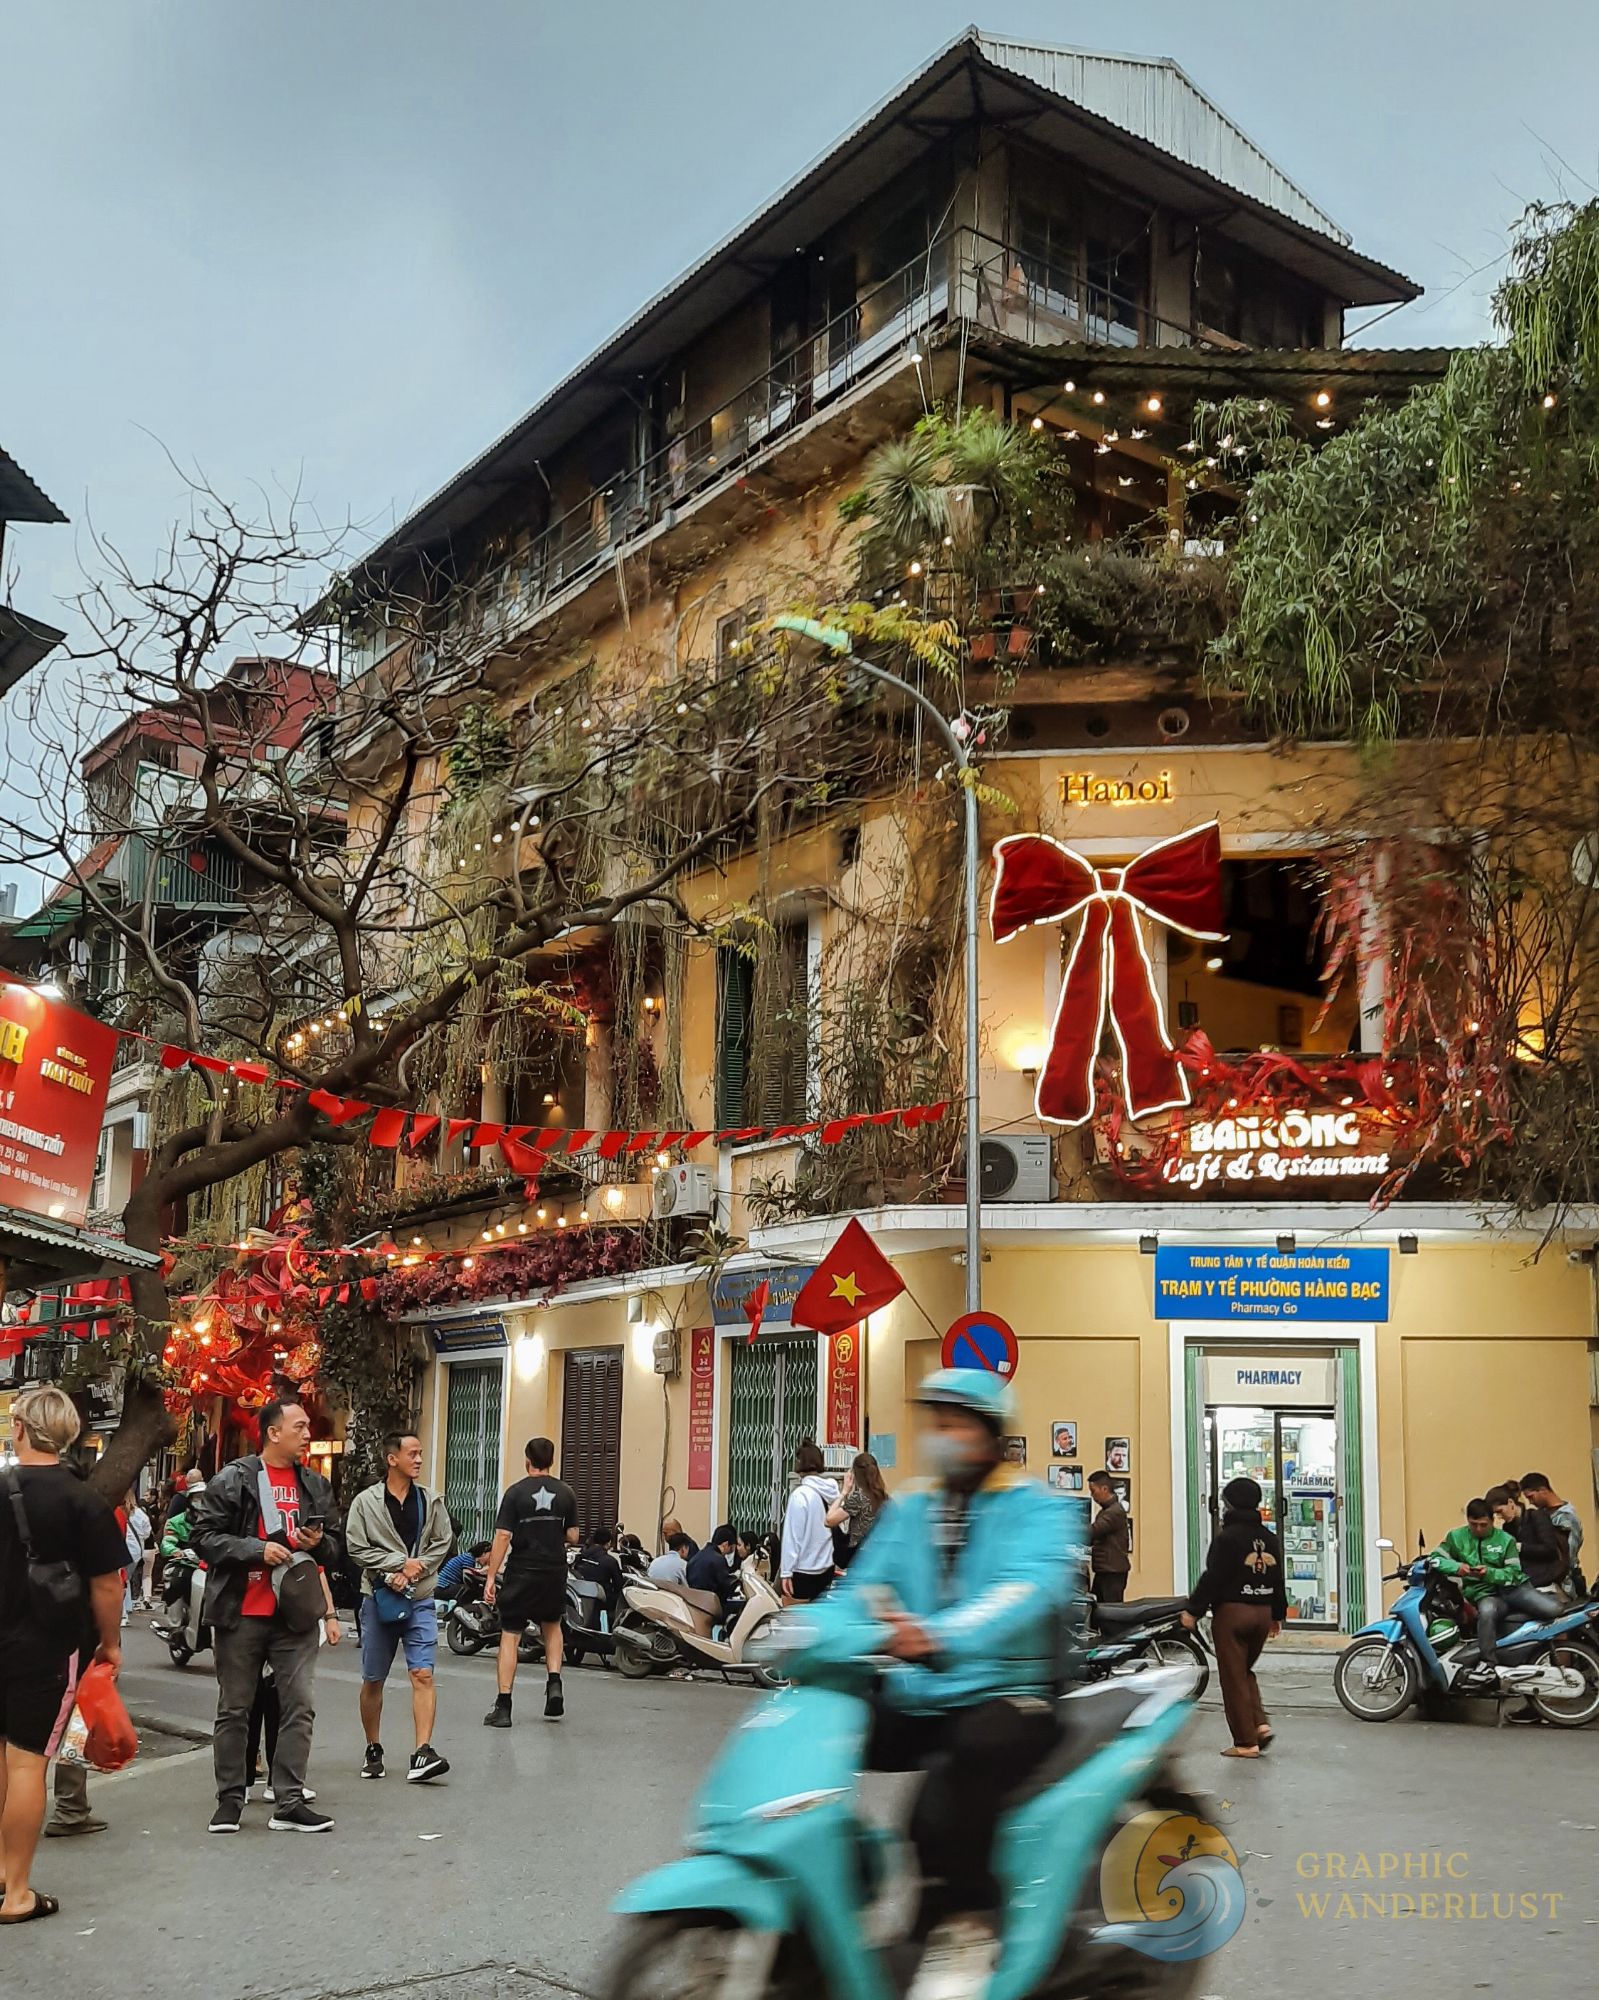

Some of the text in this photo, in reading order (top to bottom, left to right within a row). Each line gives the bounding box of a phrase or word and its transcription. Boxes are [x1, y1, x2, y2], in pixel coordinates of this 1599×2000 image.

[1061, 771, 1172, 803] Hanoi
[1162, 1153, 1222, 1190] Café
[1258, 1151, 1390, 1181] Restaurant
[1189, 1256, 1220, 1268] TRUNG
[1224, 1254, 1243, 1268] TÂM
[1246, 1256, 1253, 1268] Y
[1256, 1253, 1268, 1269] TẾ
[1269, 1255, 1296, 1270] QUẬN
[1298, 1254, 1325, 1269] HOÀN
[1160, 1274, 1381, 1301] TRẠM Y TẾ PHƯỜNG HÀNG BẠC
[1230, 1301, 1297, 1316] Pharmacy Go
[1236, 1370, 1302, 1385] PHARMACY
[1291, 1476, 1335, 1487] PHARMAC
